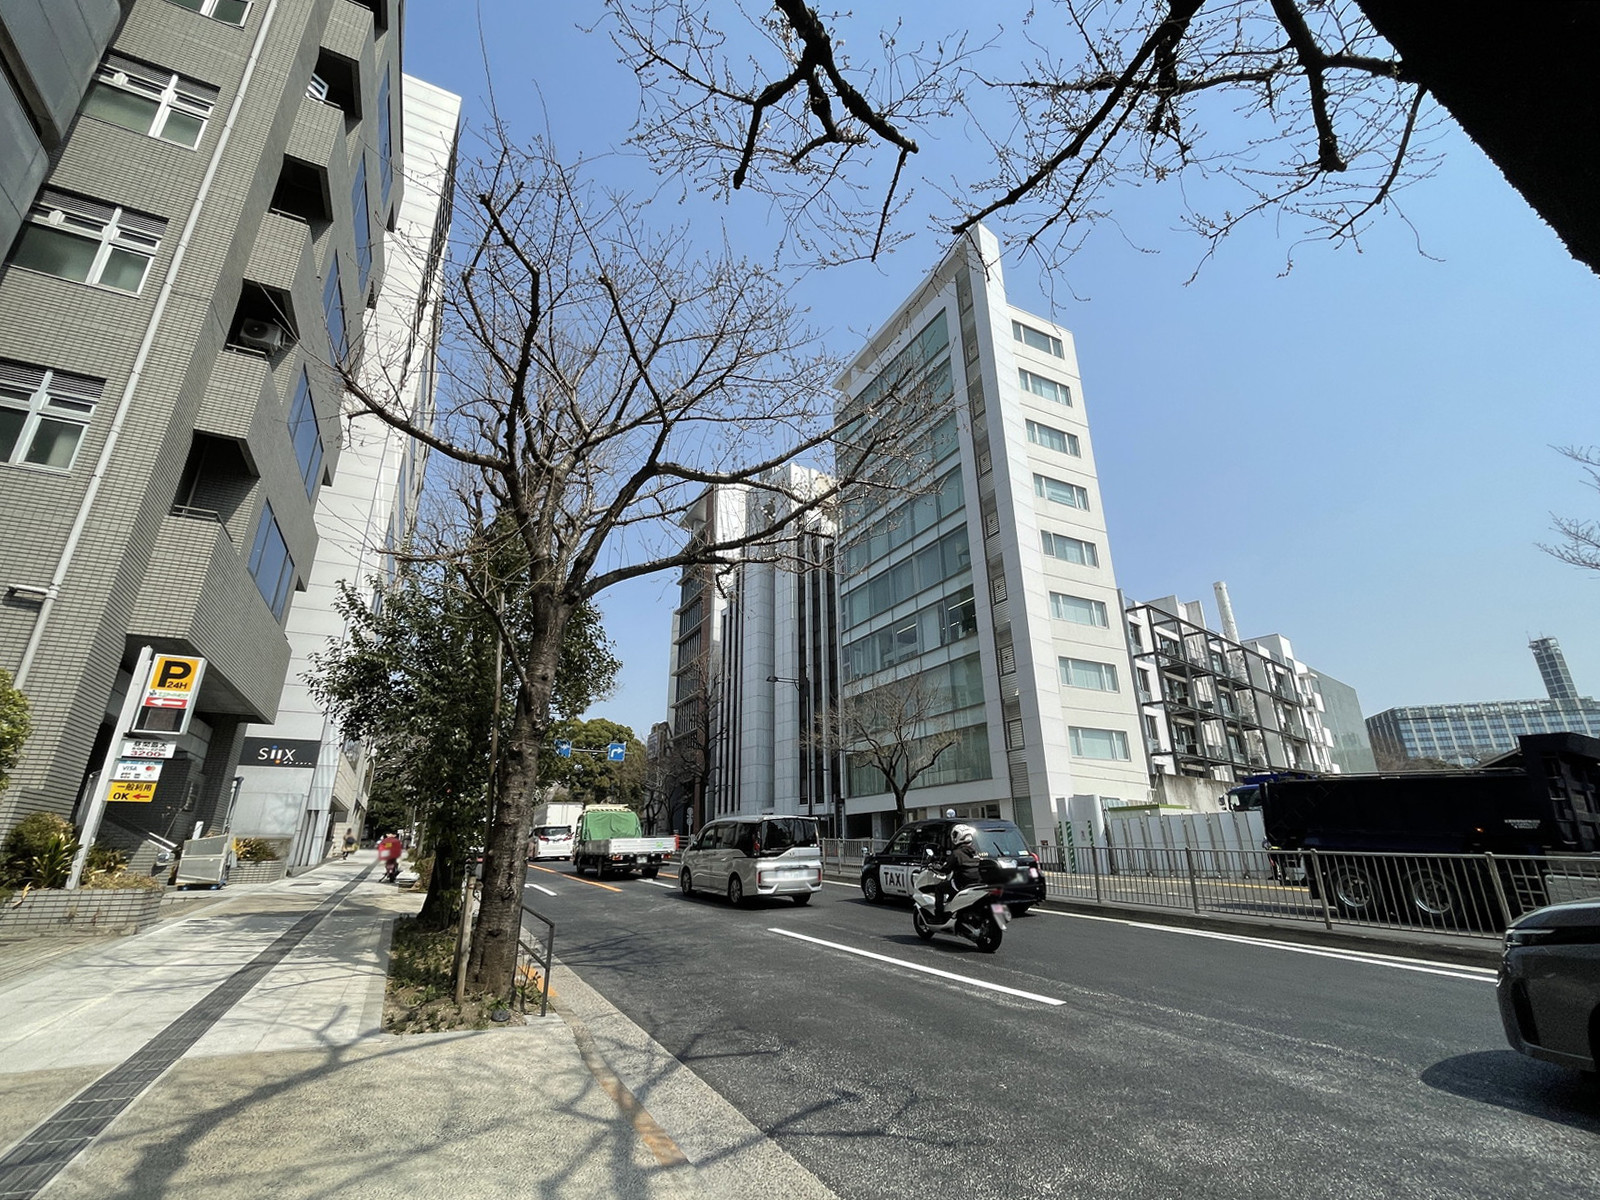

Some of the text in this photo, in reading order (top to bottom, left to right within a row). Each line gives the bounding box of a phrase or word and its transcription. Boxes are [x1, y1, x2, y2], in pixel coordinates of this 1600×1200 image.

[157, 660, 192, 688] P
[166, 681, 188, 689] 24H
[117, 783, 152, 791] 一般利用
[113, 792, 130, 800] OK
[884, 871, 905, 888] TAXI
